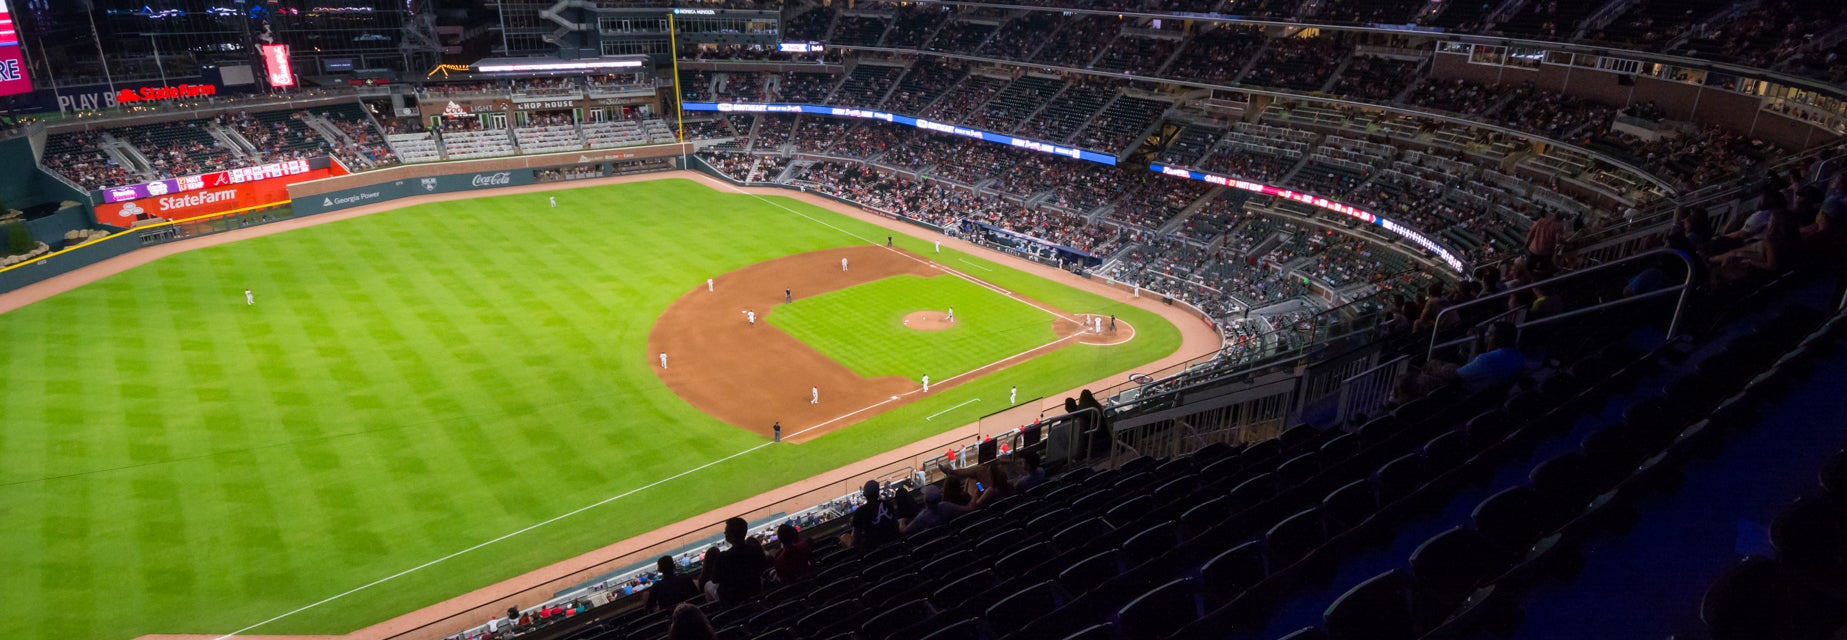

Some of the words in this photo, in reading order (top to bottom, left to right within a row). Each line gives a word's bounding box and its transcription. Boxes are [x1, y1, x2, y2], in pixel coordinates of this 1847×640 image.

[58, 92, 103, 113] PLAY
[518, 102, 542, 110] CHOP
[186, 175, 202, 183] MATT
[472, 172, 511, 187] Coca-Cola
[159, 189, 236, 211] StateFarm
[334, 194, 360, 205] Georgia
[360, 191, 380, 200] Power
